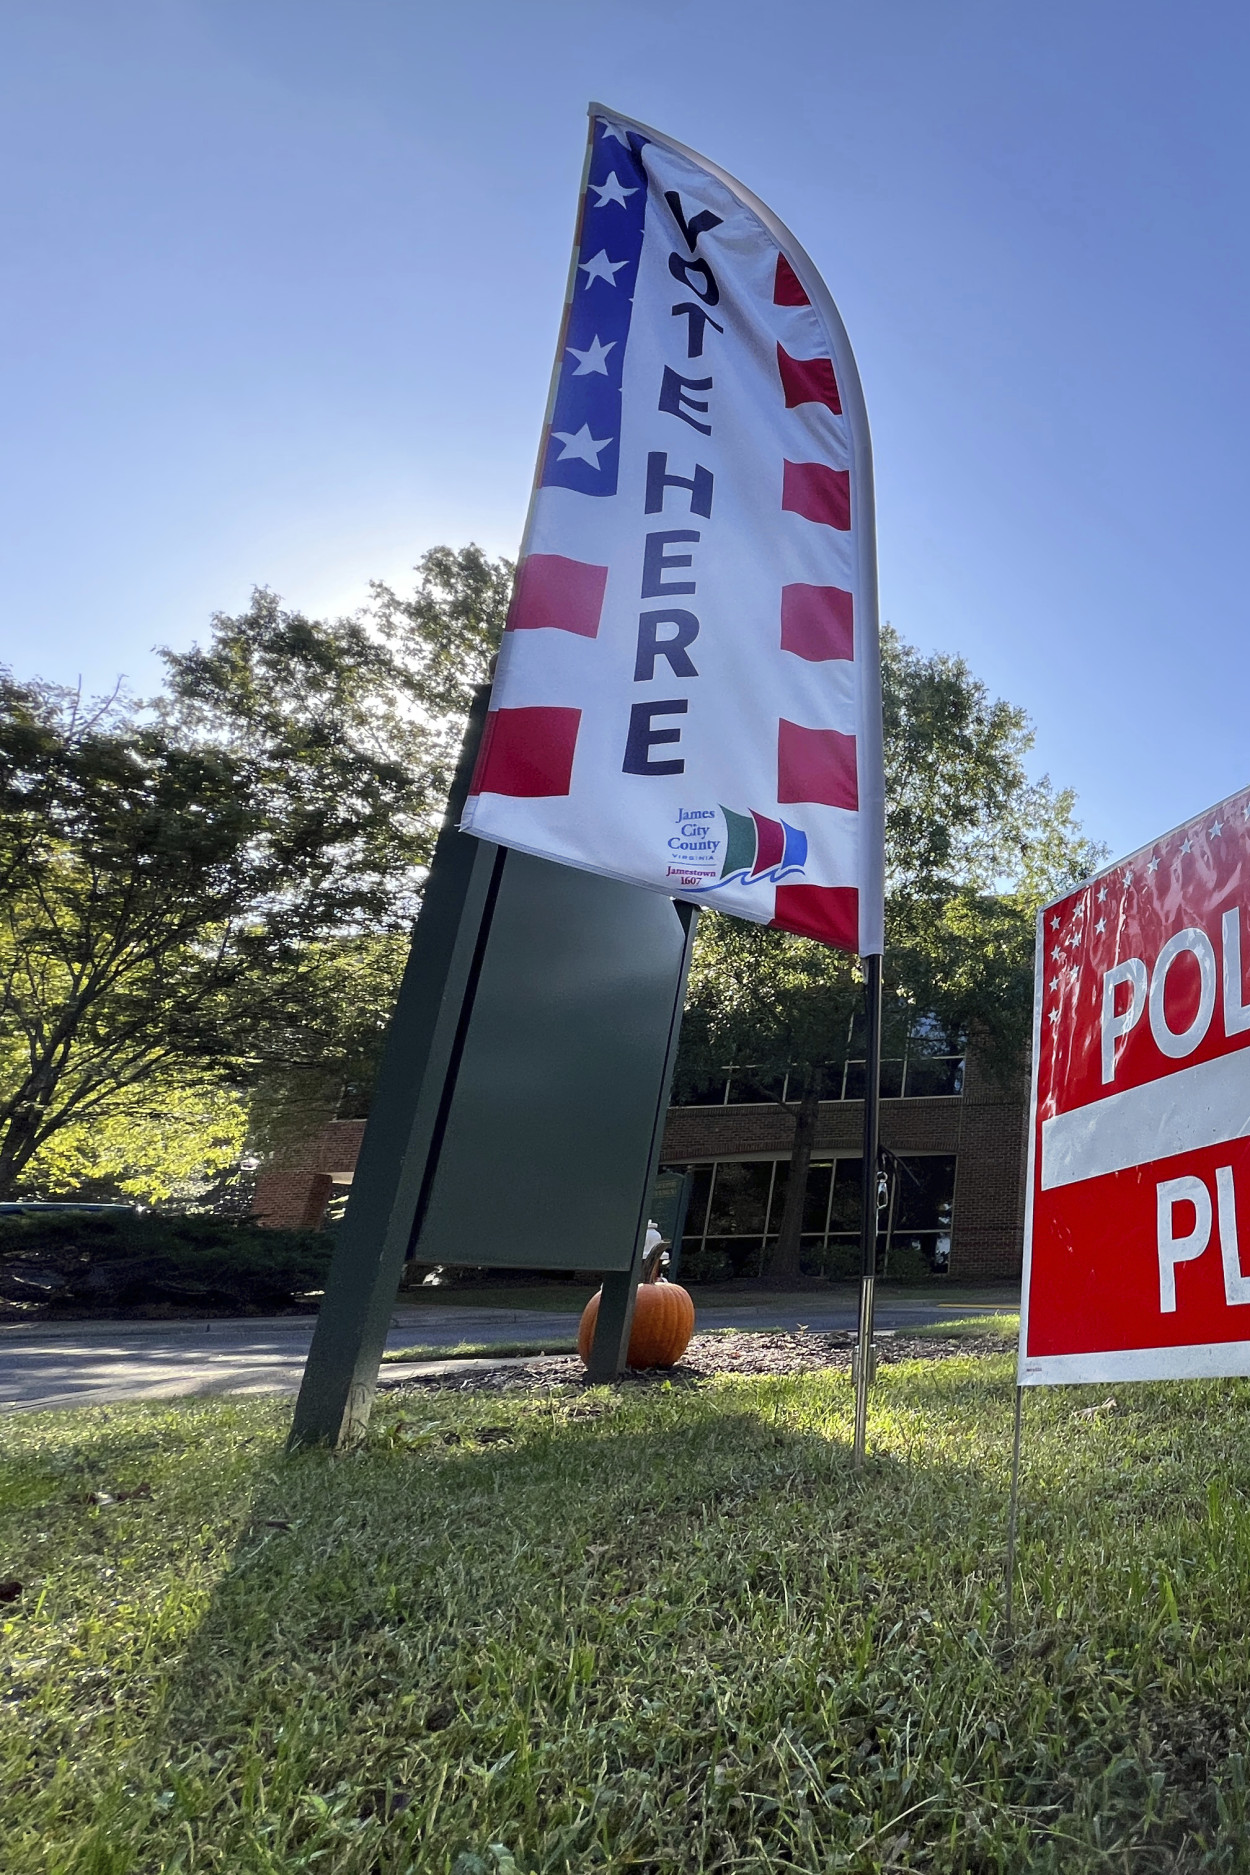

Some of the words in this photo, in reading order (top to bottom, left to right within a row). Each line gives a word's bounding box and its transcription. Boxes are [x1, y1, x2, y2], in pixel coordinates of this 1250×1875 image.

[658, 190, 724, 437] VOTE
[622, 450, 714, 777] HERE
[675, 807, 716, 823] James
[681, 823, 710, 840] City
[667, 837, 720, 854] County
[671, 853, 714, 861] VIRGINIA
[665, 866, 717, 878] Jamestown
[680, 876, 703, 886] 1607
